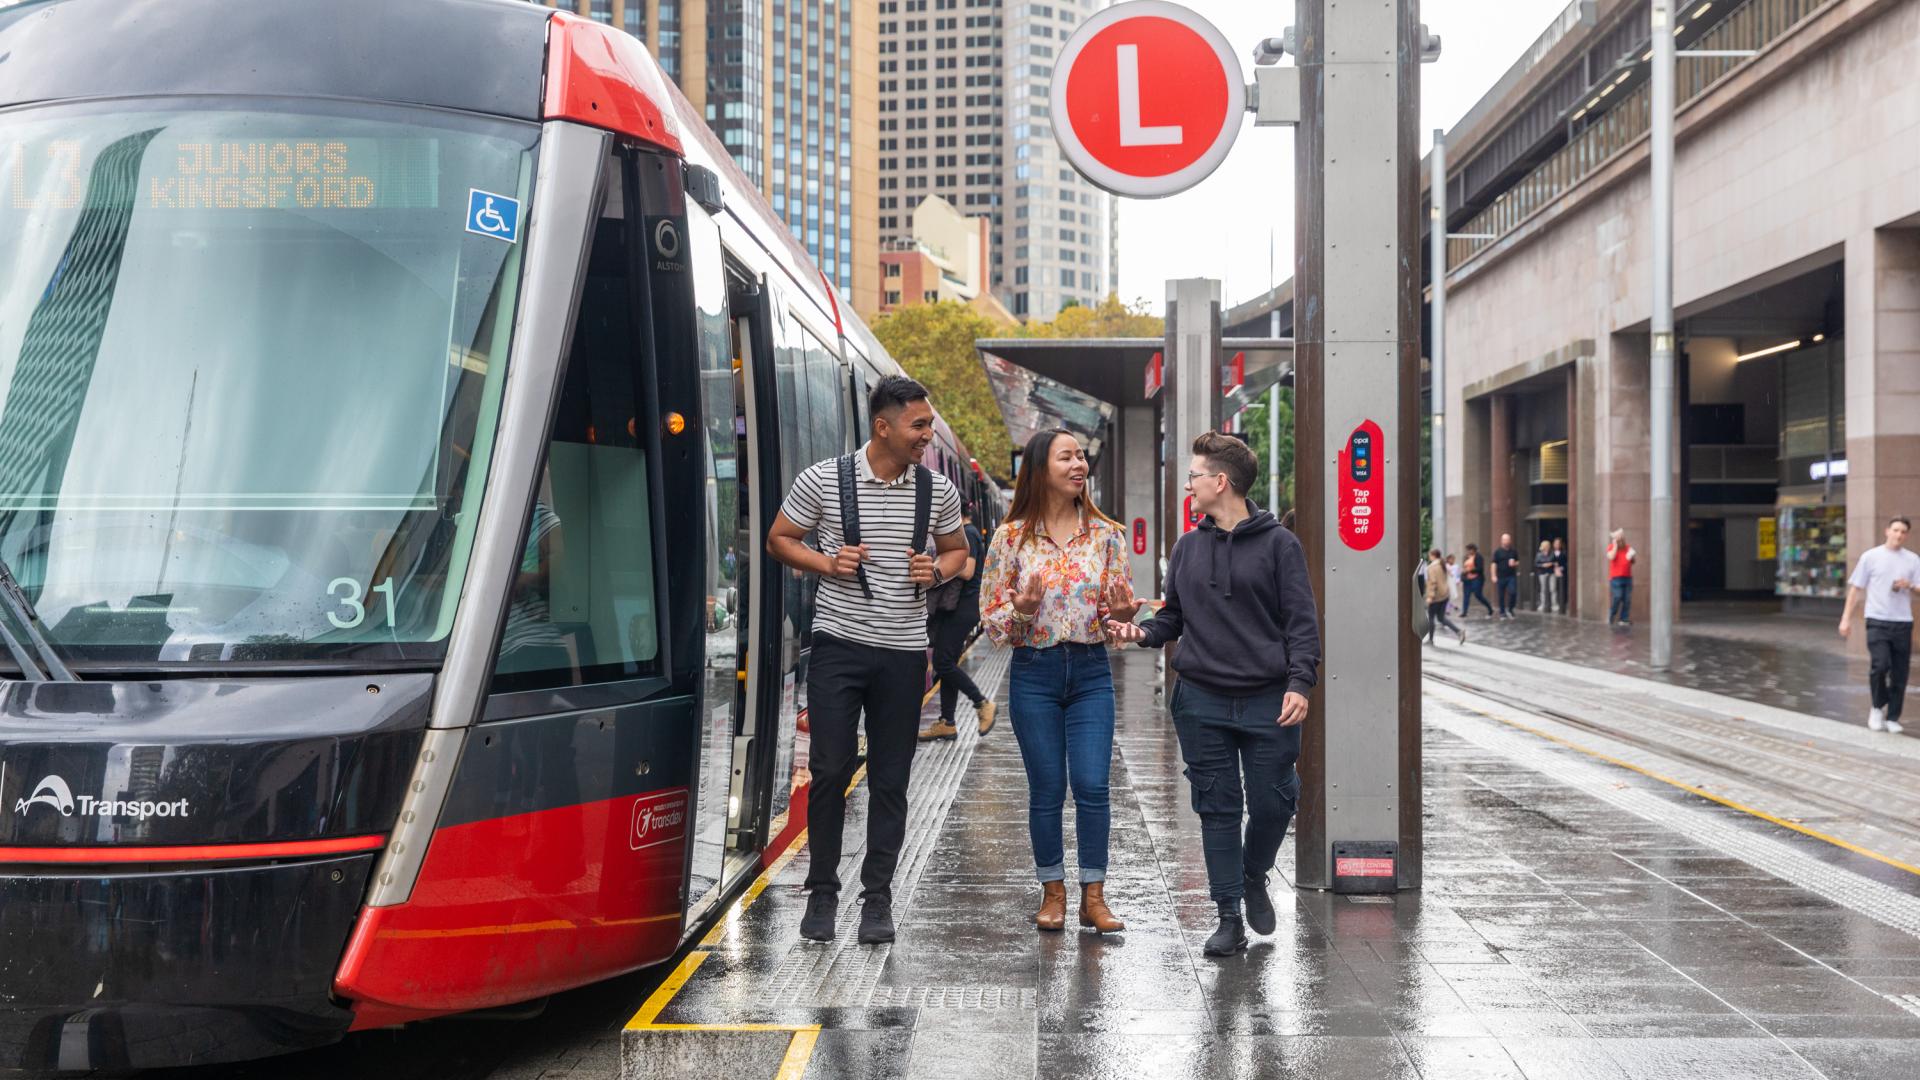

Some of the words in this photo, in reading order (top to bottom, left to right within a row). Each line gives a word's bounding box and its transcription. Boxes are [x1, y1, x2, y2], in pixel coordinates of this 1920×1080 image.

[1116, 44, 1183, 146] L
[178, 142, 351, 174] JUNIORS
[151, 176, 375, 208] KINGSFORD
[1353, 488, 1370, 498] Tap
[1353, 517, 1369, 526] tap
[1354, 526, 1368, 534] off
[326, 577, 396, 629] 31
[76, 795, 190, 821] Transport
